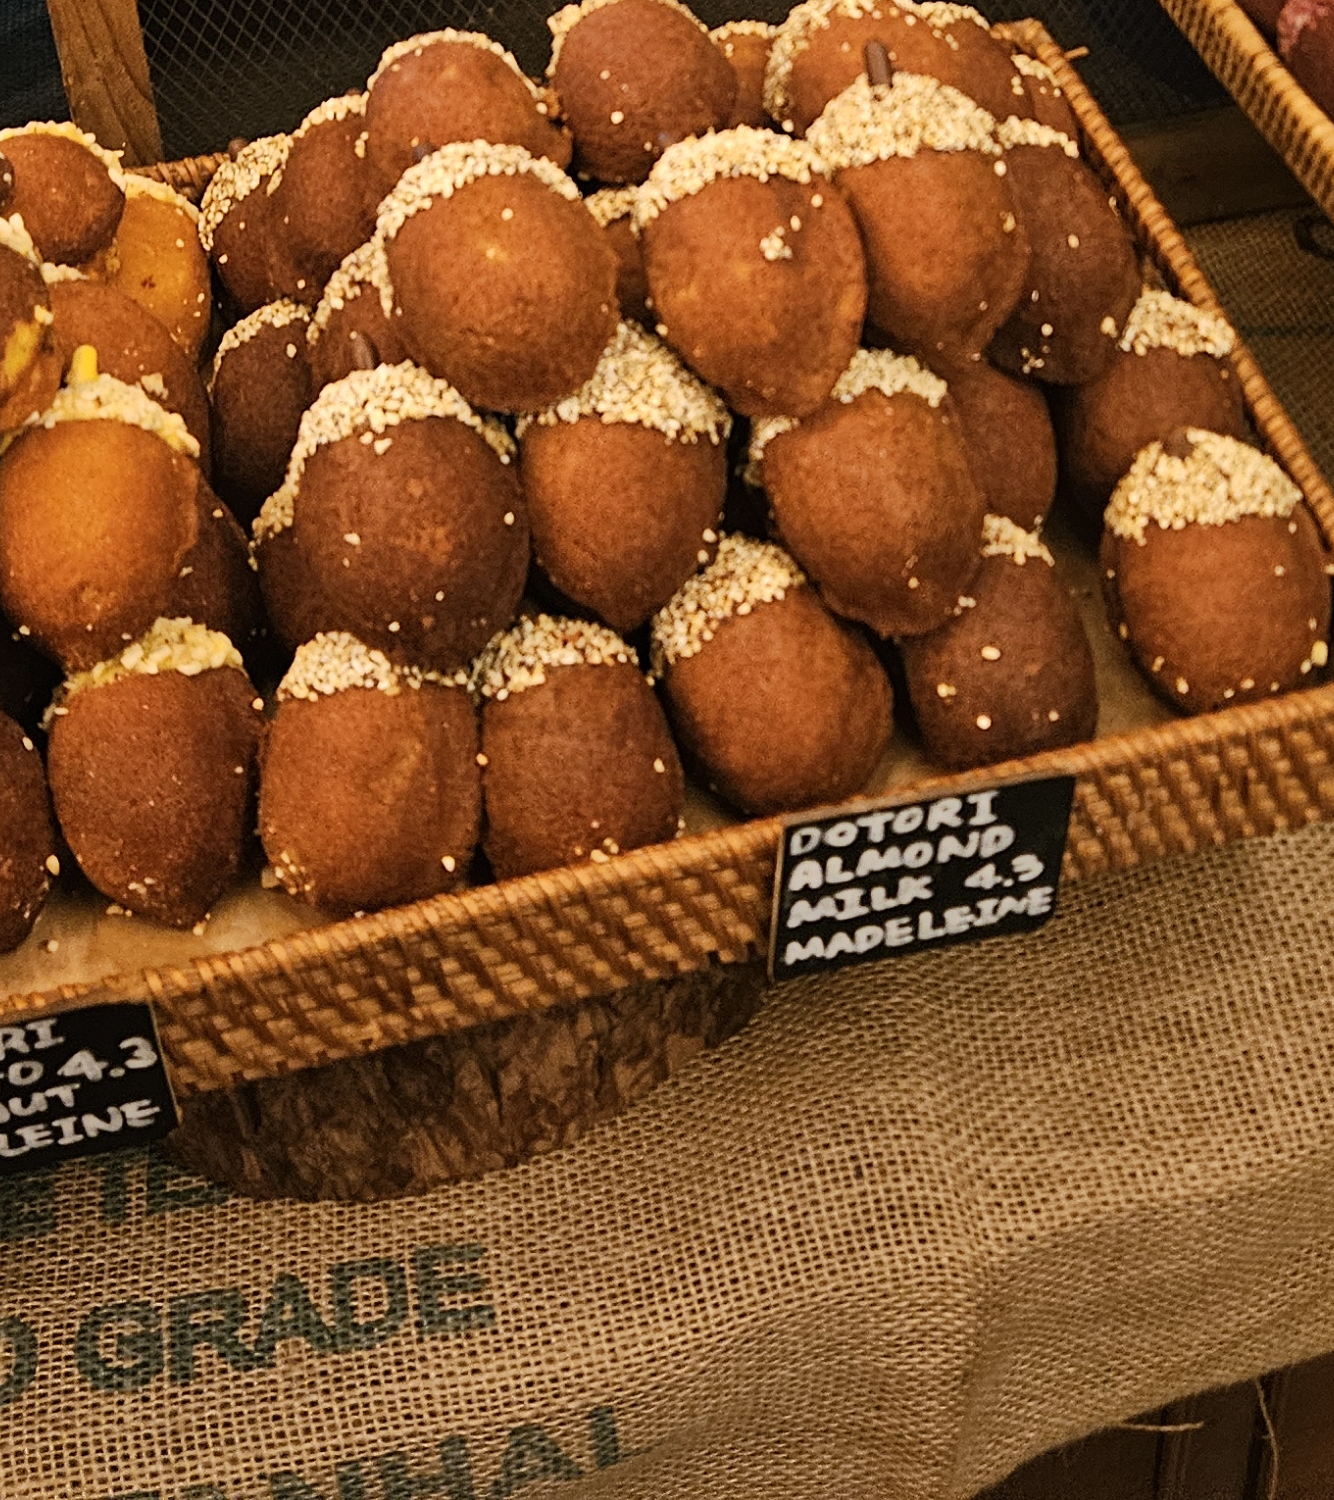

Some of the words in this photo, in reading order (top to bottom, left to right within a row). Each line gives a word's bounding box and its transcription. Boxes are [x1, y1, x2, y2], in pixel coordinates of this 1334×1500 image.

[787, 824, 1016, 892] ALMOND
[789, 789, 999, 856] DOTORI
[784, 886, 1055, 966] MADELEINE
[786, 875, 935, 930] MILK
[964, 853, 1045, 890] 4.3
[56, 1035, 158, 1082] 4.3
[73, 1239, 496, 1393] GRADE
